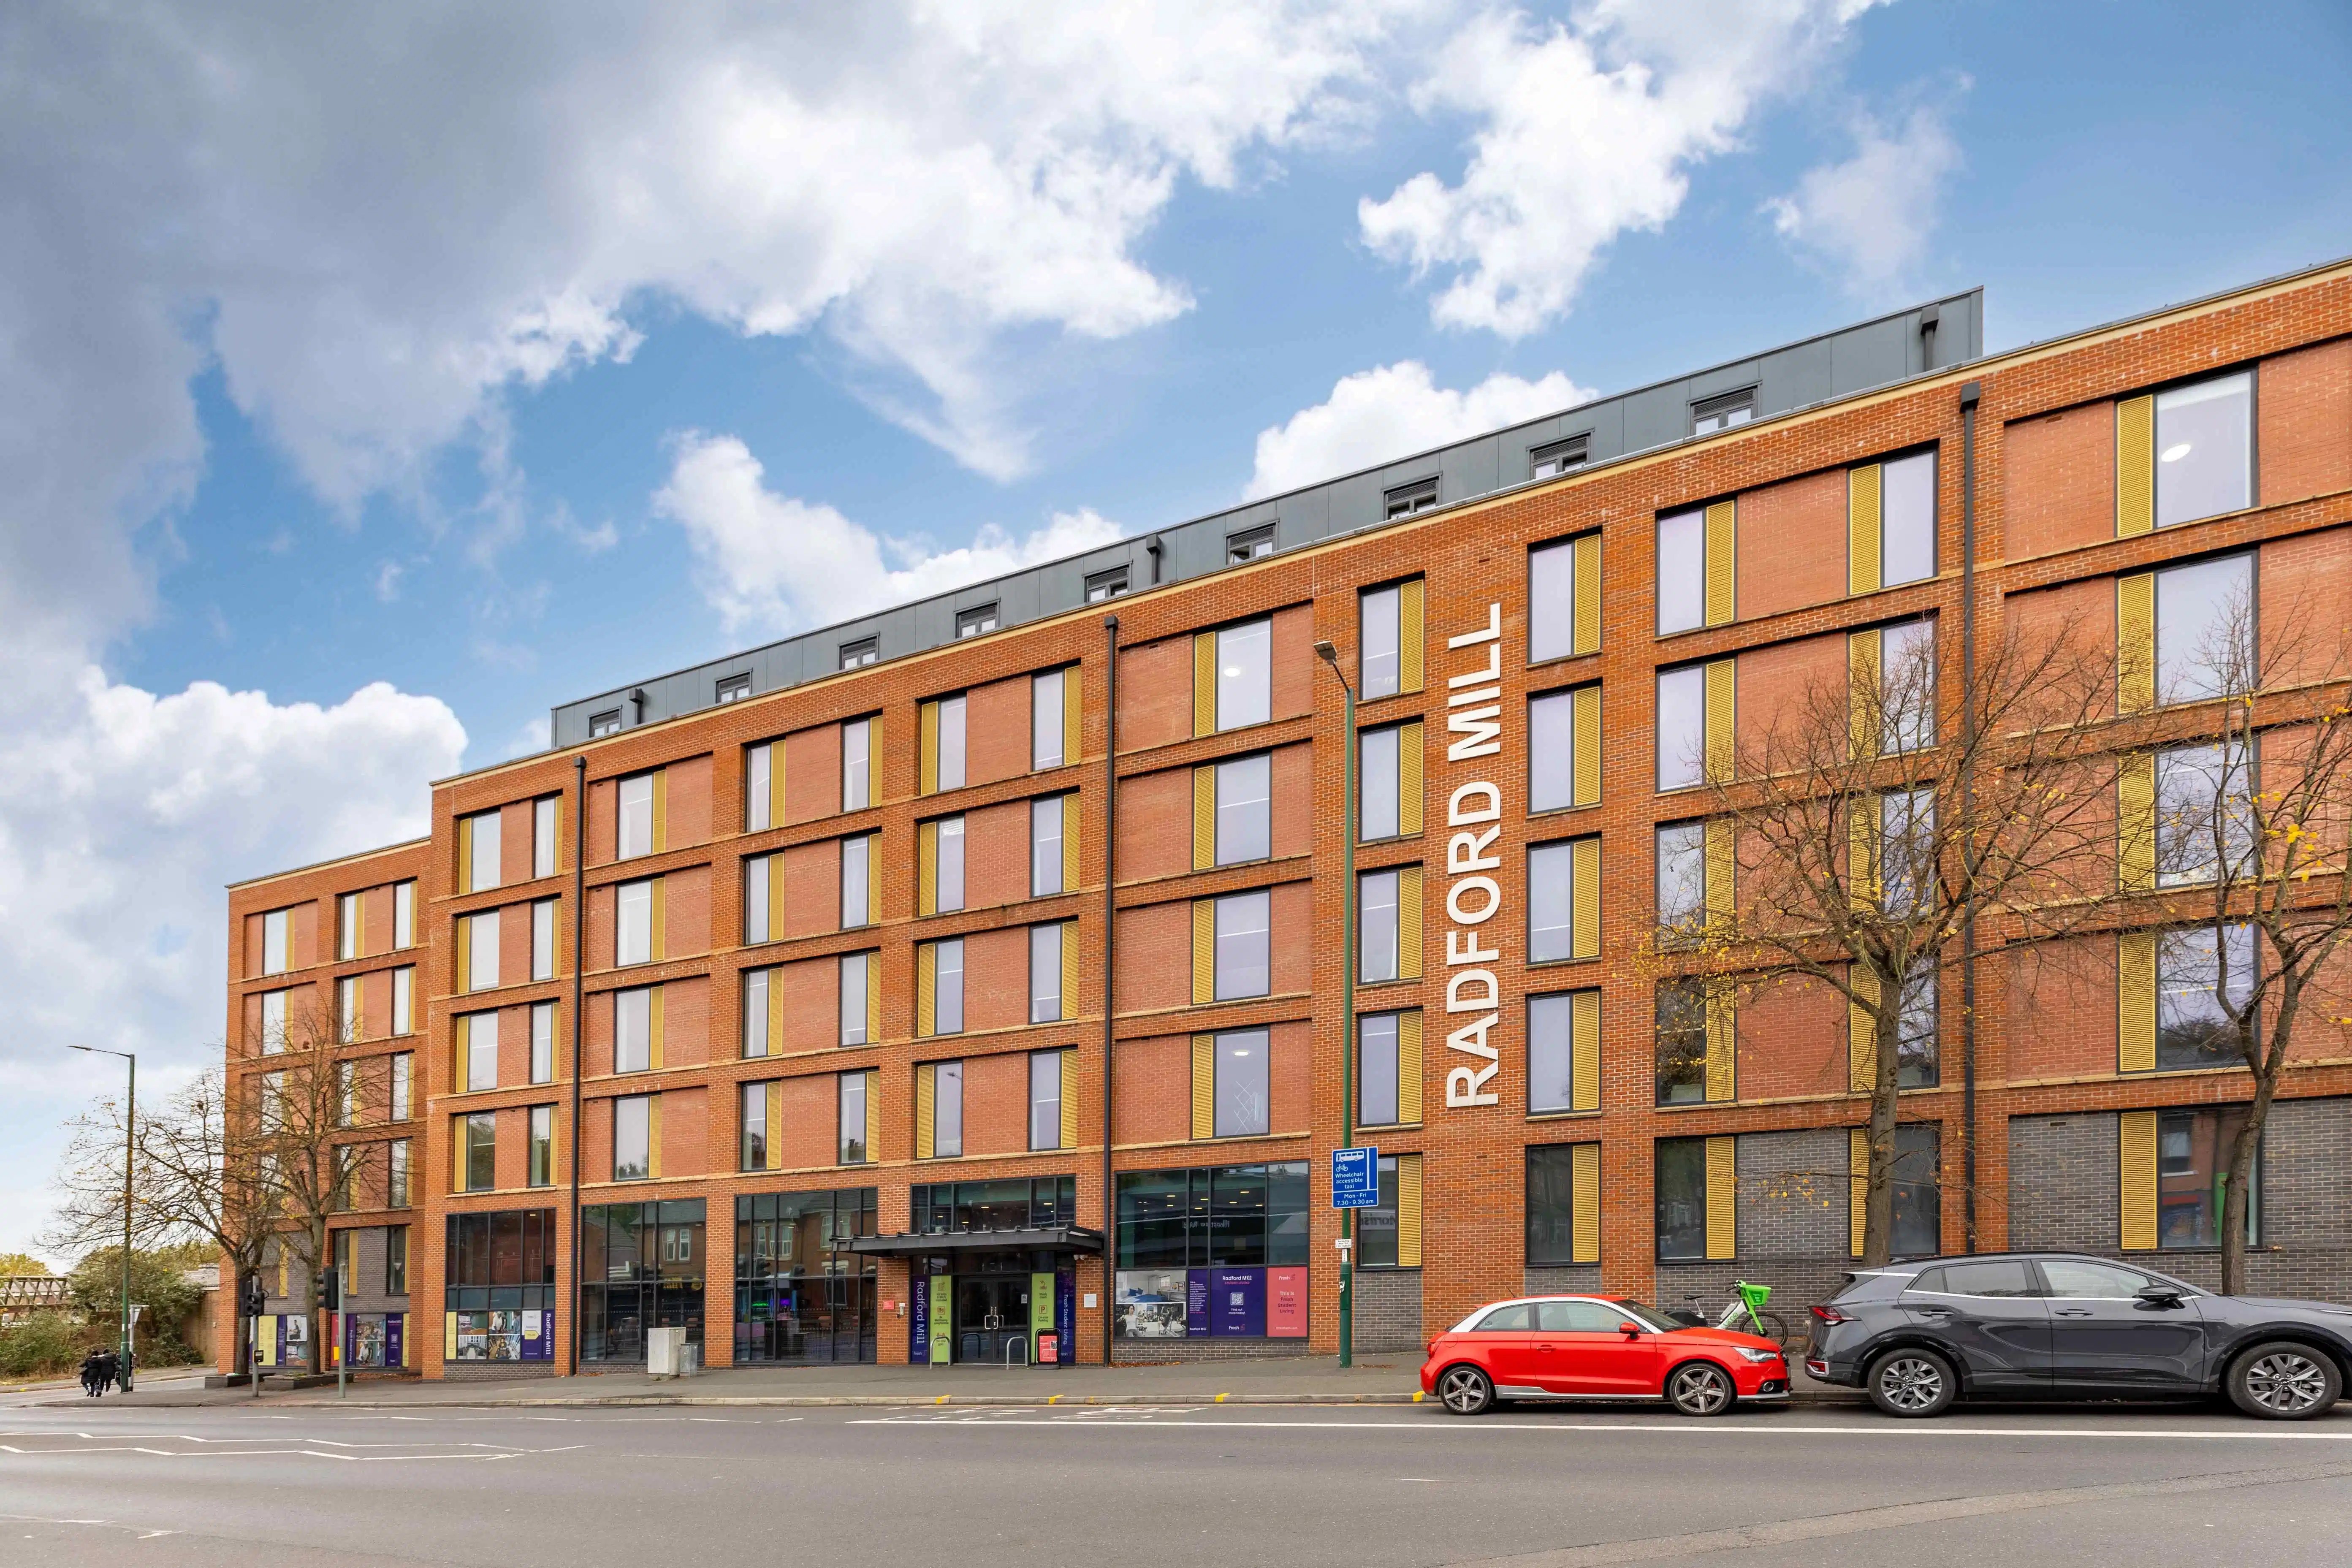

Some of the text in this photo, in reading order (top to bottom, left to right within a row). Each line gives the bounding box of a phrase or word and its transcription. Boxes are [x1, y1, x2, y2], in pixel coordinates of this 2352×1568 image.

[1447, 603, 1500, 1107] RADFORD MILL
[917, 1281, 925, 1344] Radford Mill
